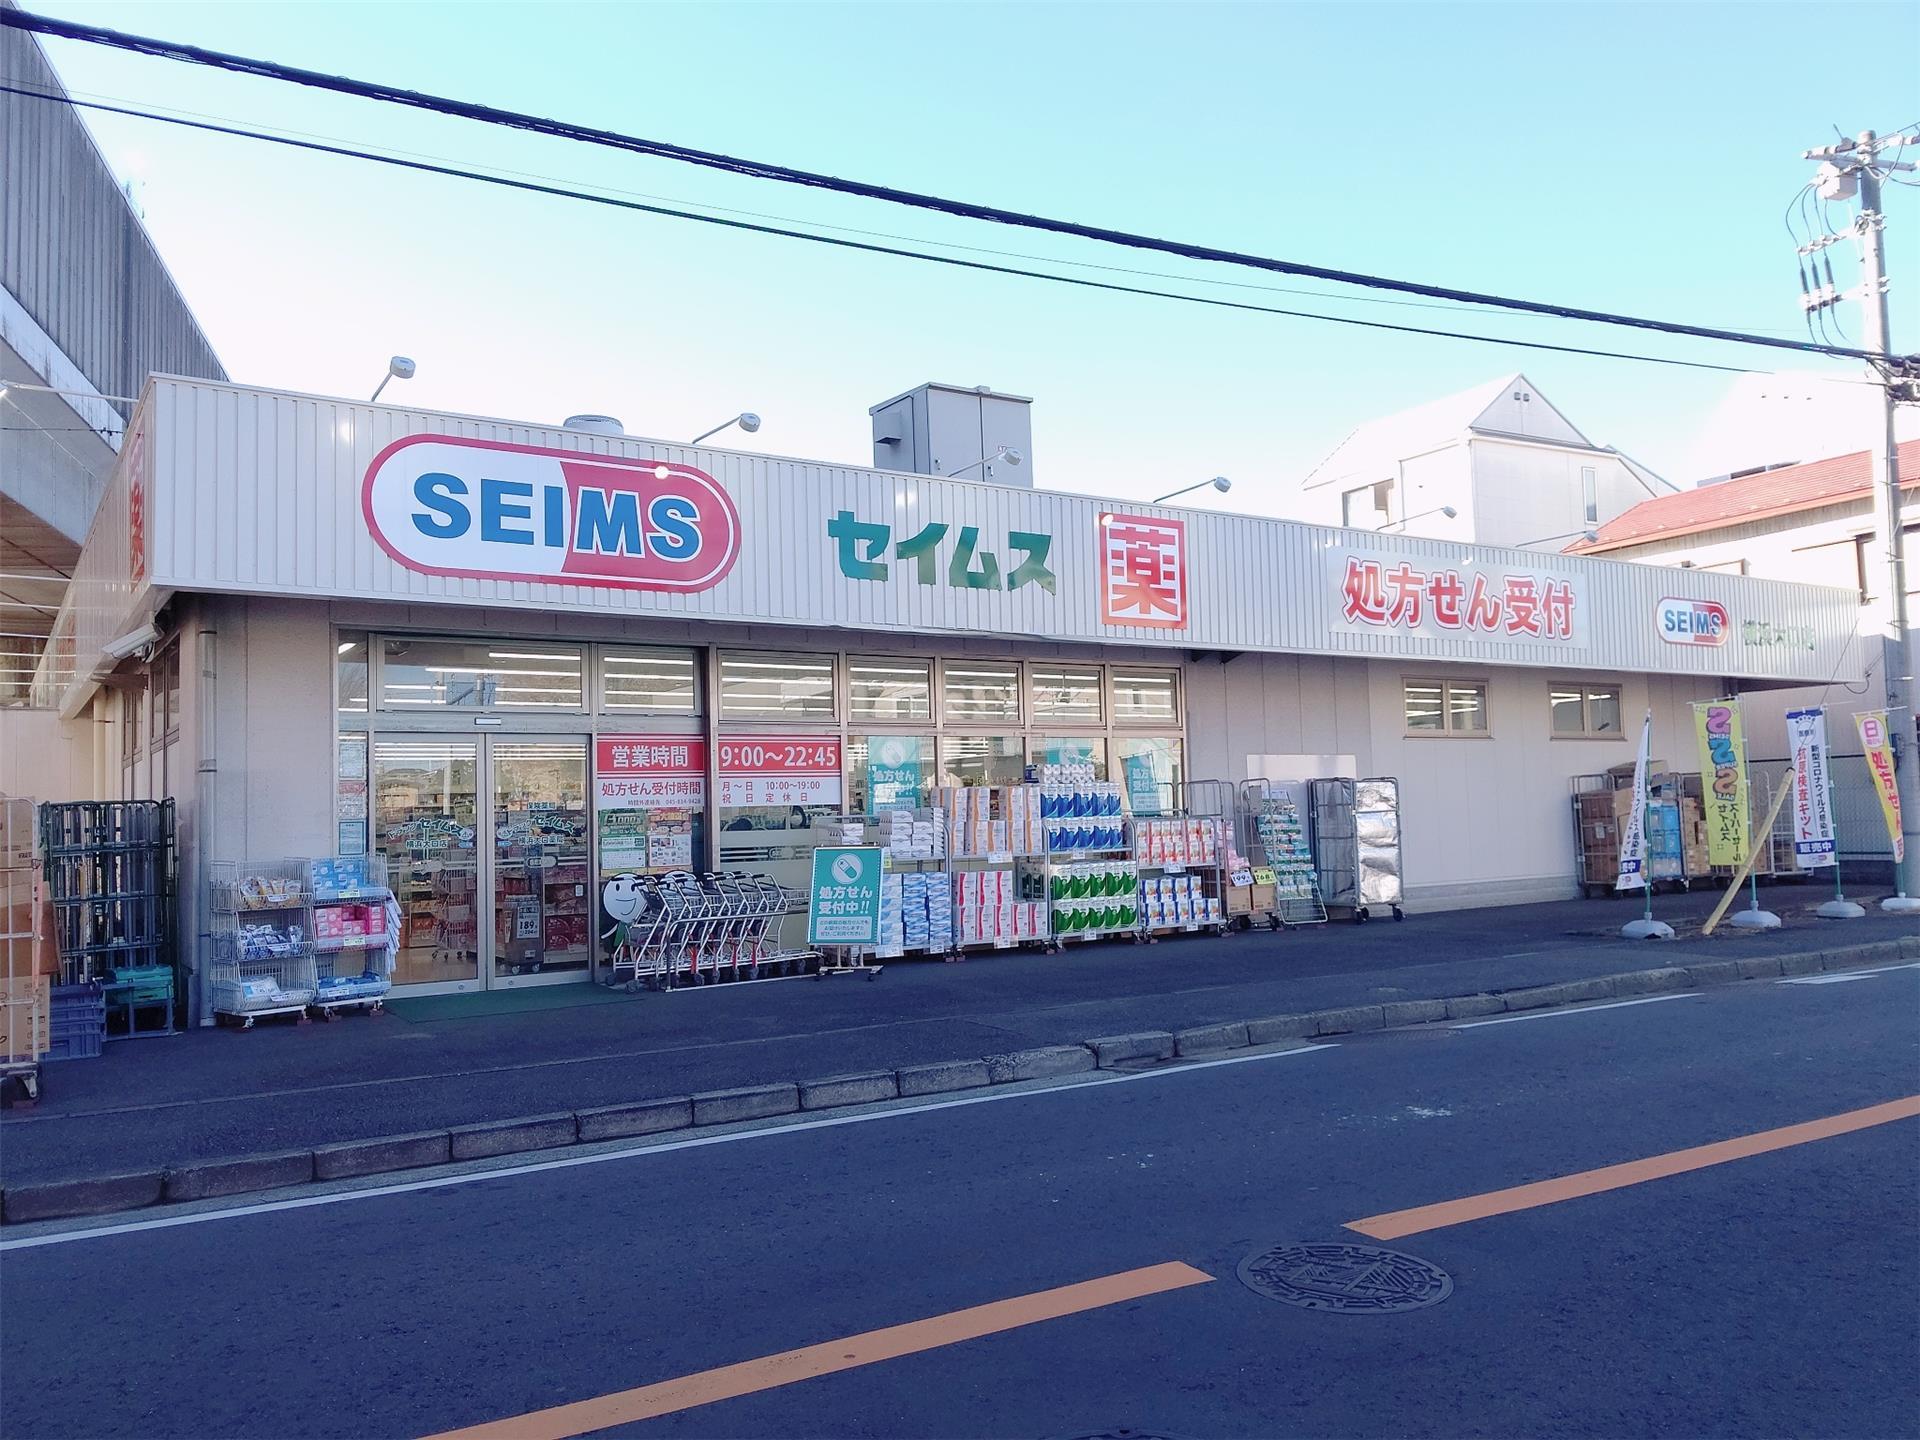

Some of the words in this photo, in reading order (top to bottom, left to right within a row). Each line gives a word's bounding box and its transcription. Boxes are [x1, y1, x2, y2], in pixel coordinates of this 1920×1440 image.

[411, 472, 703, 562] SEIMS
[827, 510, 1057, 598] セイムス
[1107, 525, 1179, 618] 薬
[1340, 555, 1577, 641] 処方せん受付
[1664, 608, 1722, 637] SEIMS
[611, 745, 688, 768] 営業時間
[601, 781, 701, 796] 処方せん受付時間
[1799, 841, 1833, 853] 販売中
[819, 885, 873, 899] 処方せん
